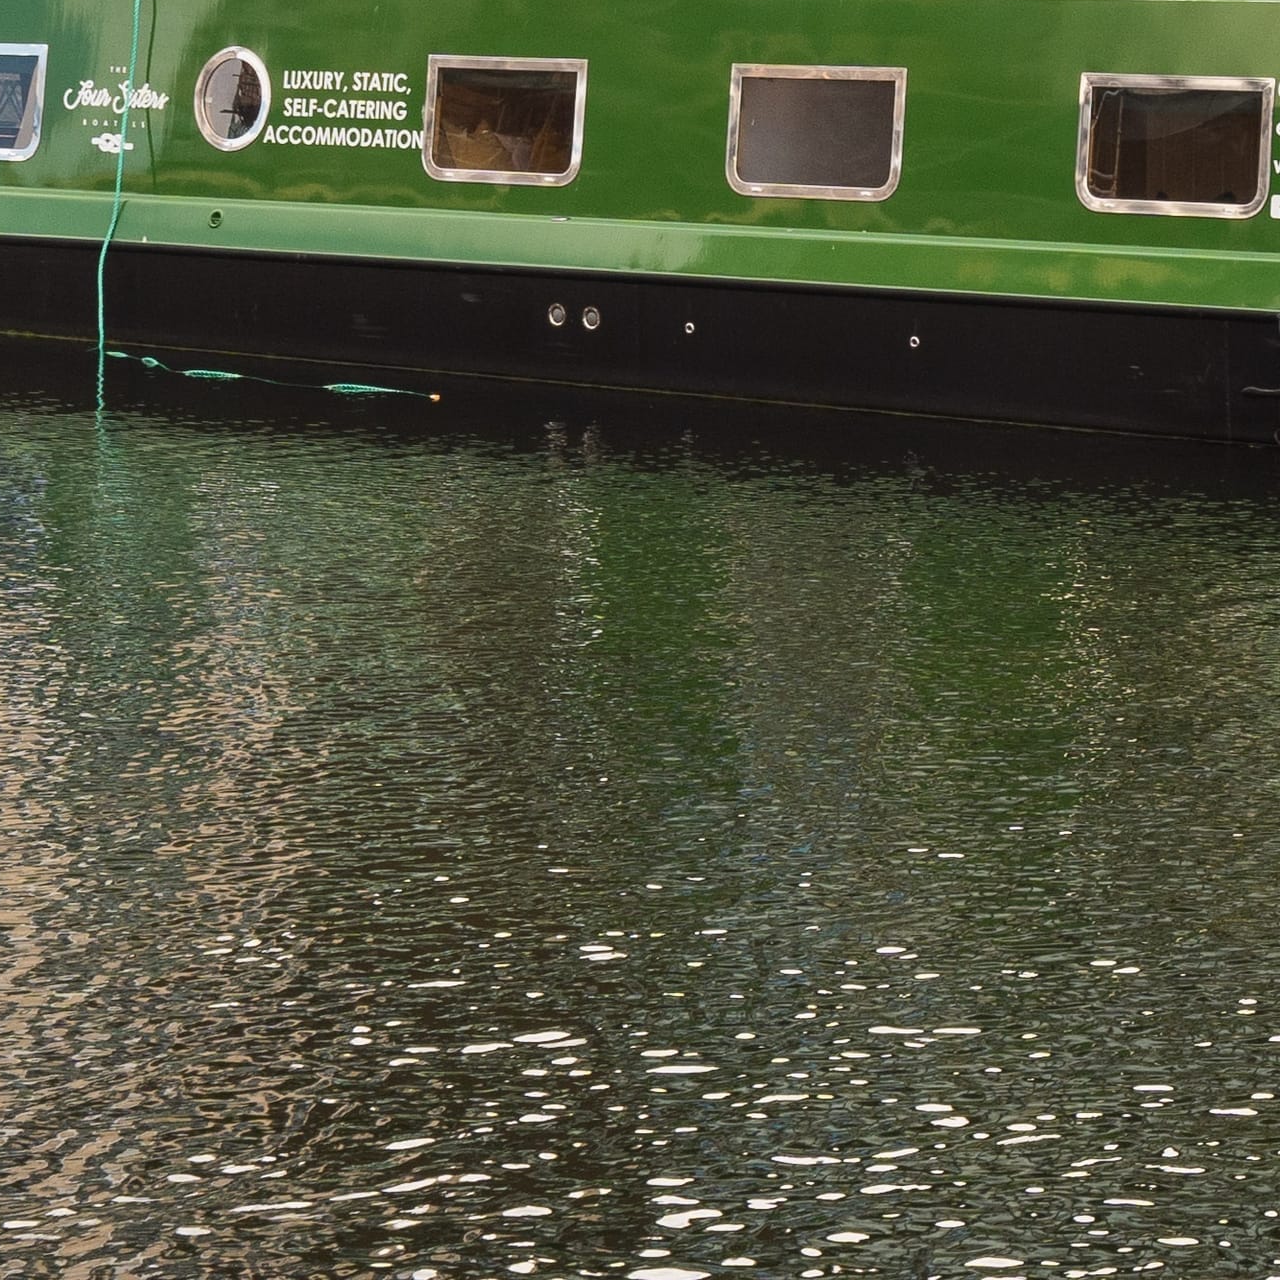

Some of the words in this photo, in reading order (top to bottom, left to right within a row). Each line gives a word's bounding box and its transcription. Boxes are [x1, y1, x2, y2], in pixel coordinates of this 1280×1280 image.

[110, 66, 127, 75] THE
[283, 70, 348, 93] LUXURY,
[352, 71, 412, 95] STATIC,
[63, 80, 112, 110] Four
[283, 98, 408, 121] SELF-CATERING
[263, 125, 424, 150] ACCOMMODATION
